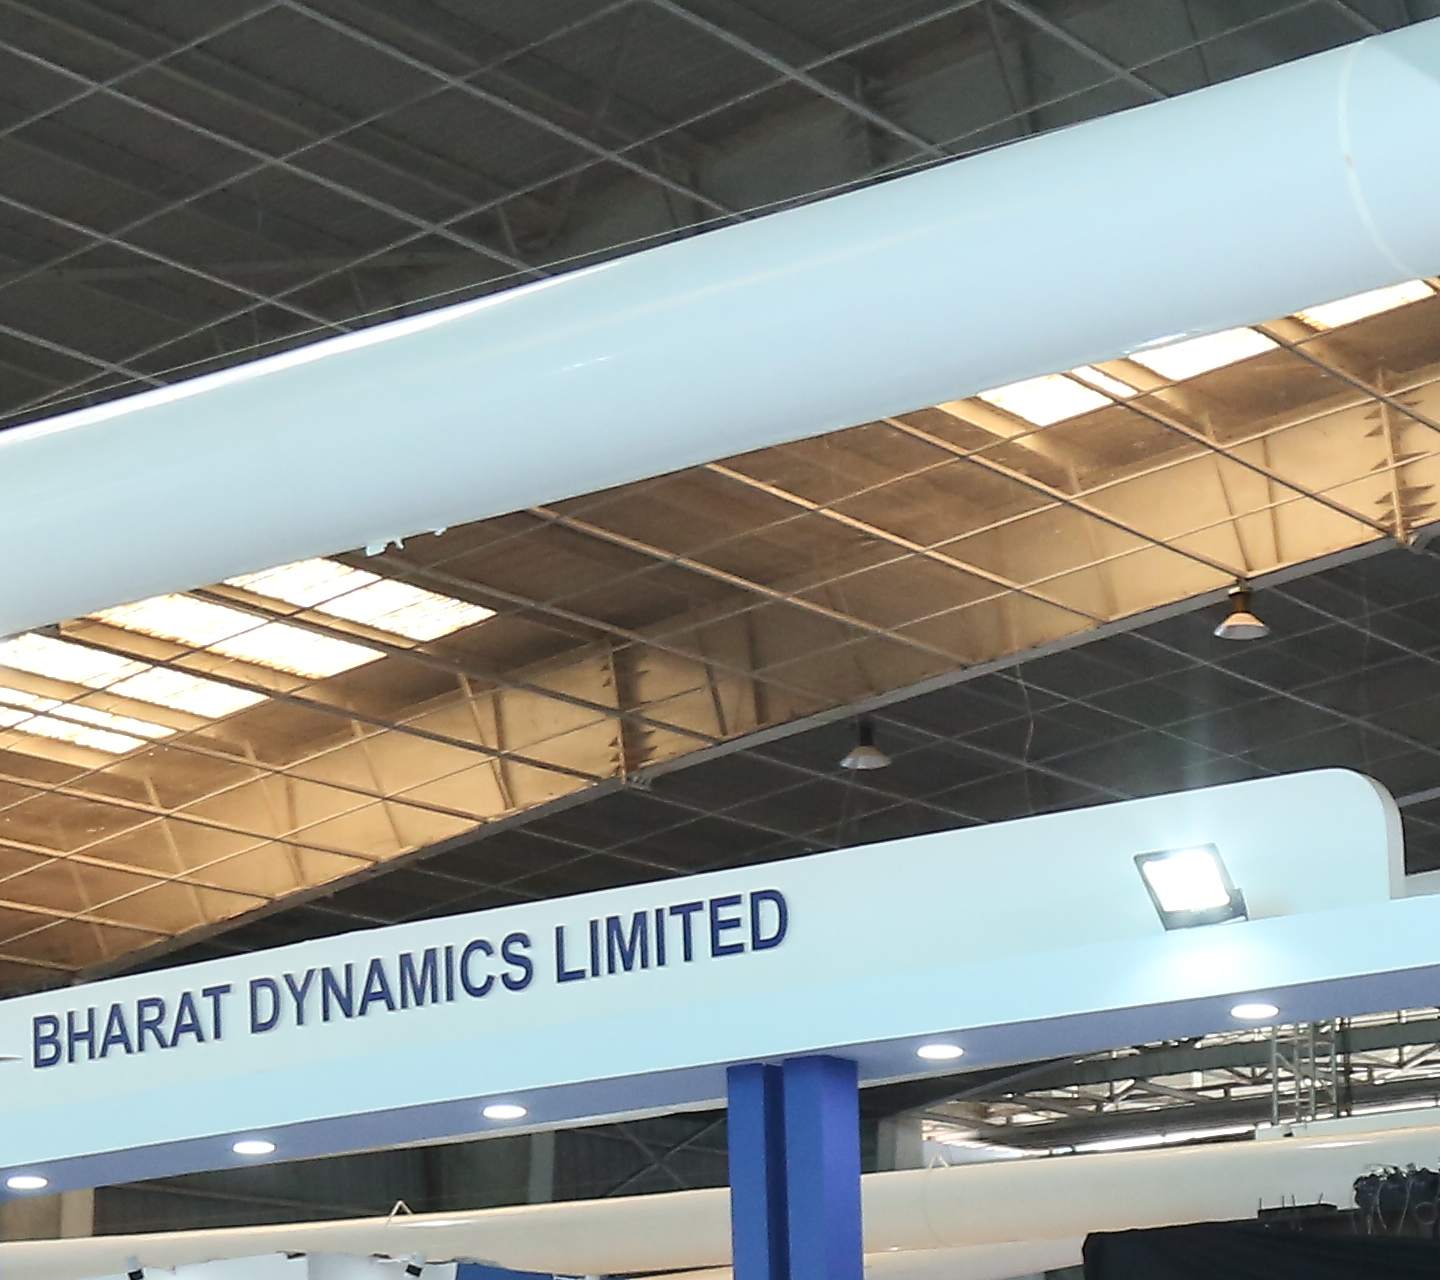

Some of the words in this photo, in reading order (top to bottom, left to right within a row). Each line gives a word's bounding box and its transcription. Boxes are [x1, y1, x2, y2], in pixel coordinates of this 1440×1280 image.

[33, 984, 232, 1070] BHARAT
[250, 933, 534, 1034] DYNAMICS
[554, 888, 789, 984] LIMITED
